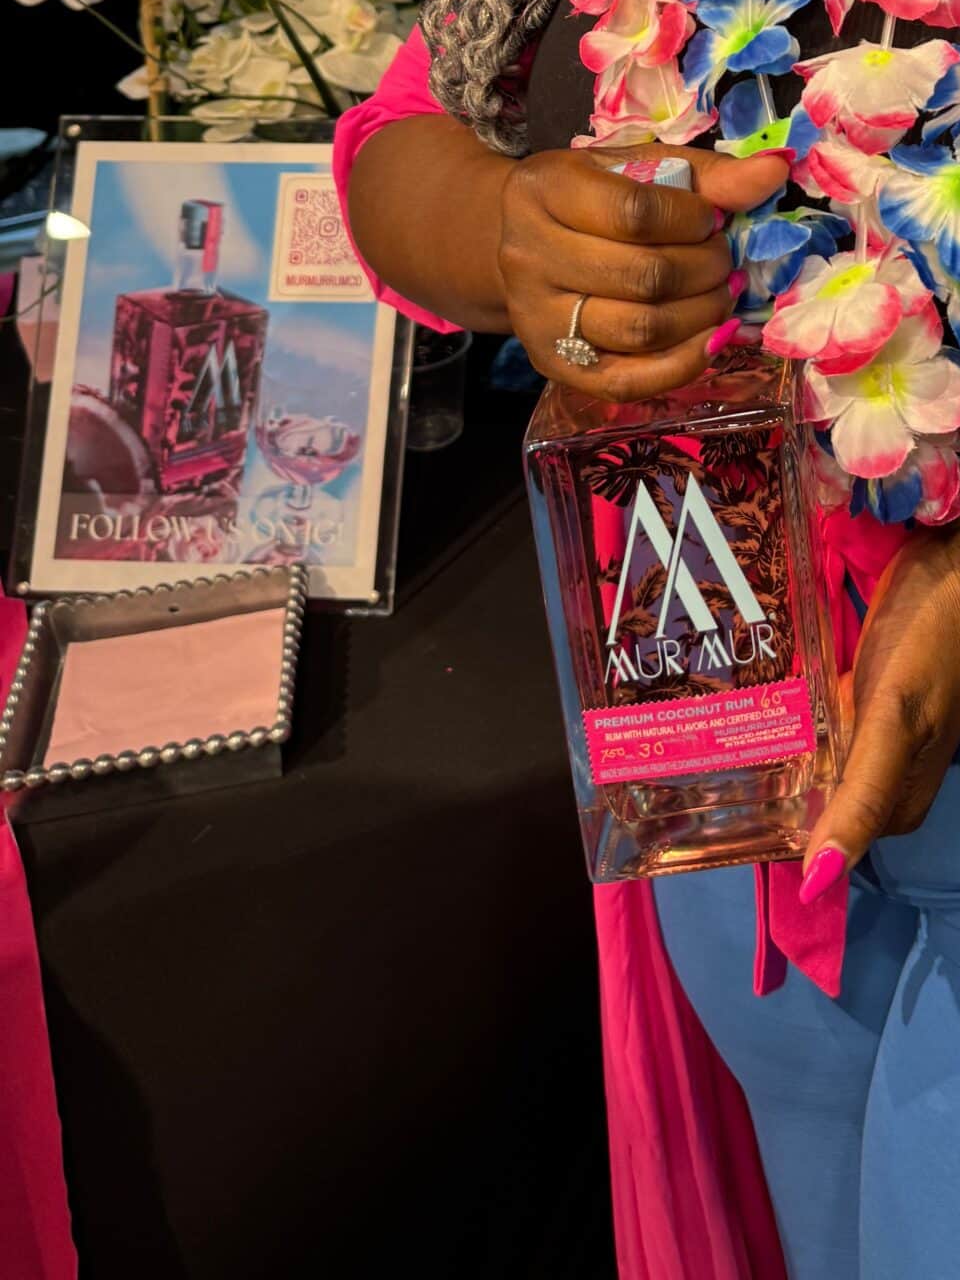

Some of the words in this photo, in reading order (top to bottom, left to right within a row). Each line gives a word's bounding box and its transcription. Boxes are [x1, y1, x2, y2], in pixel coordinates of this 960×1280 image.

[69, 513, 193, 542] FOLLOW
[605, 639, 684, 684] MUR
[697, 623, 776, 671] MUR
[594, 713, 654, 730] PREMIUM
[657, 703, 722, 721] COCONUT
[725, 696, 755, 711] RUM
[709, 716, 726, 728] AND
